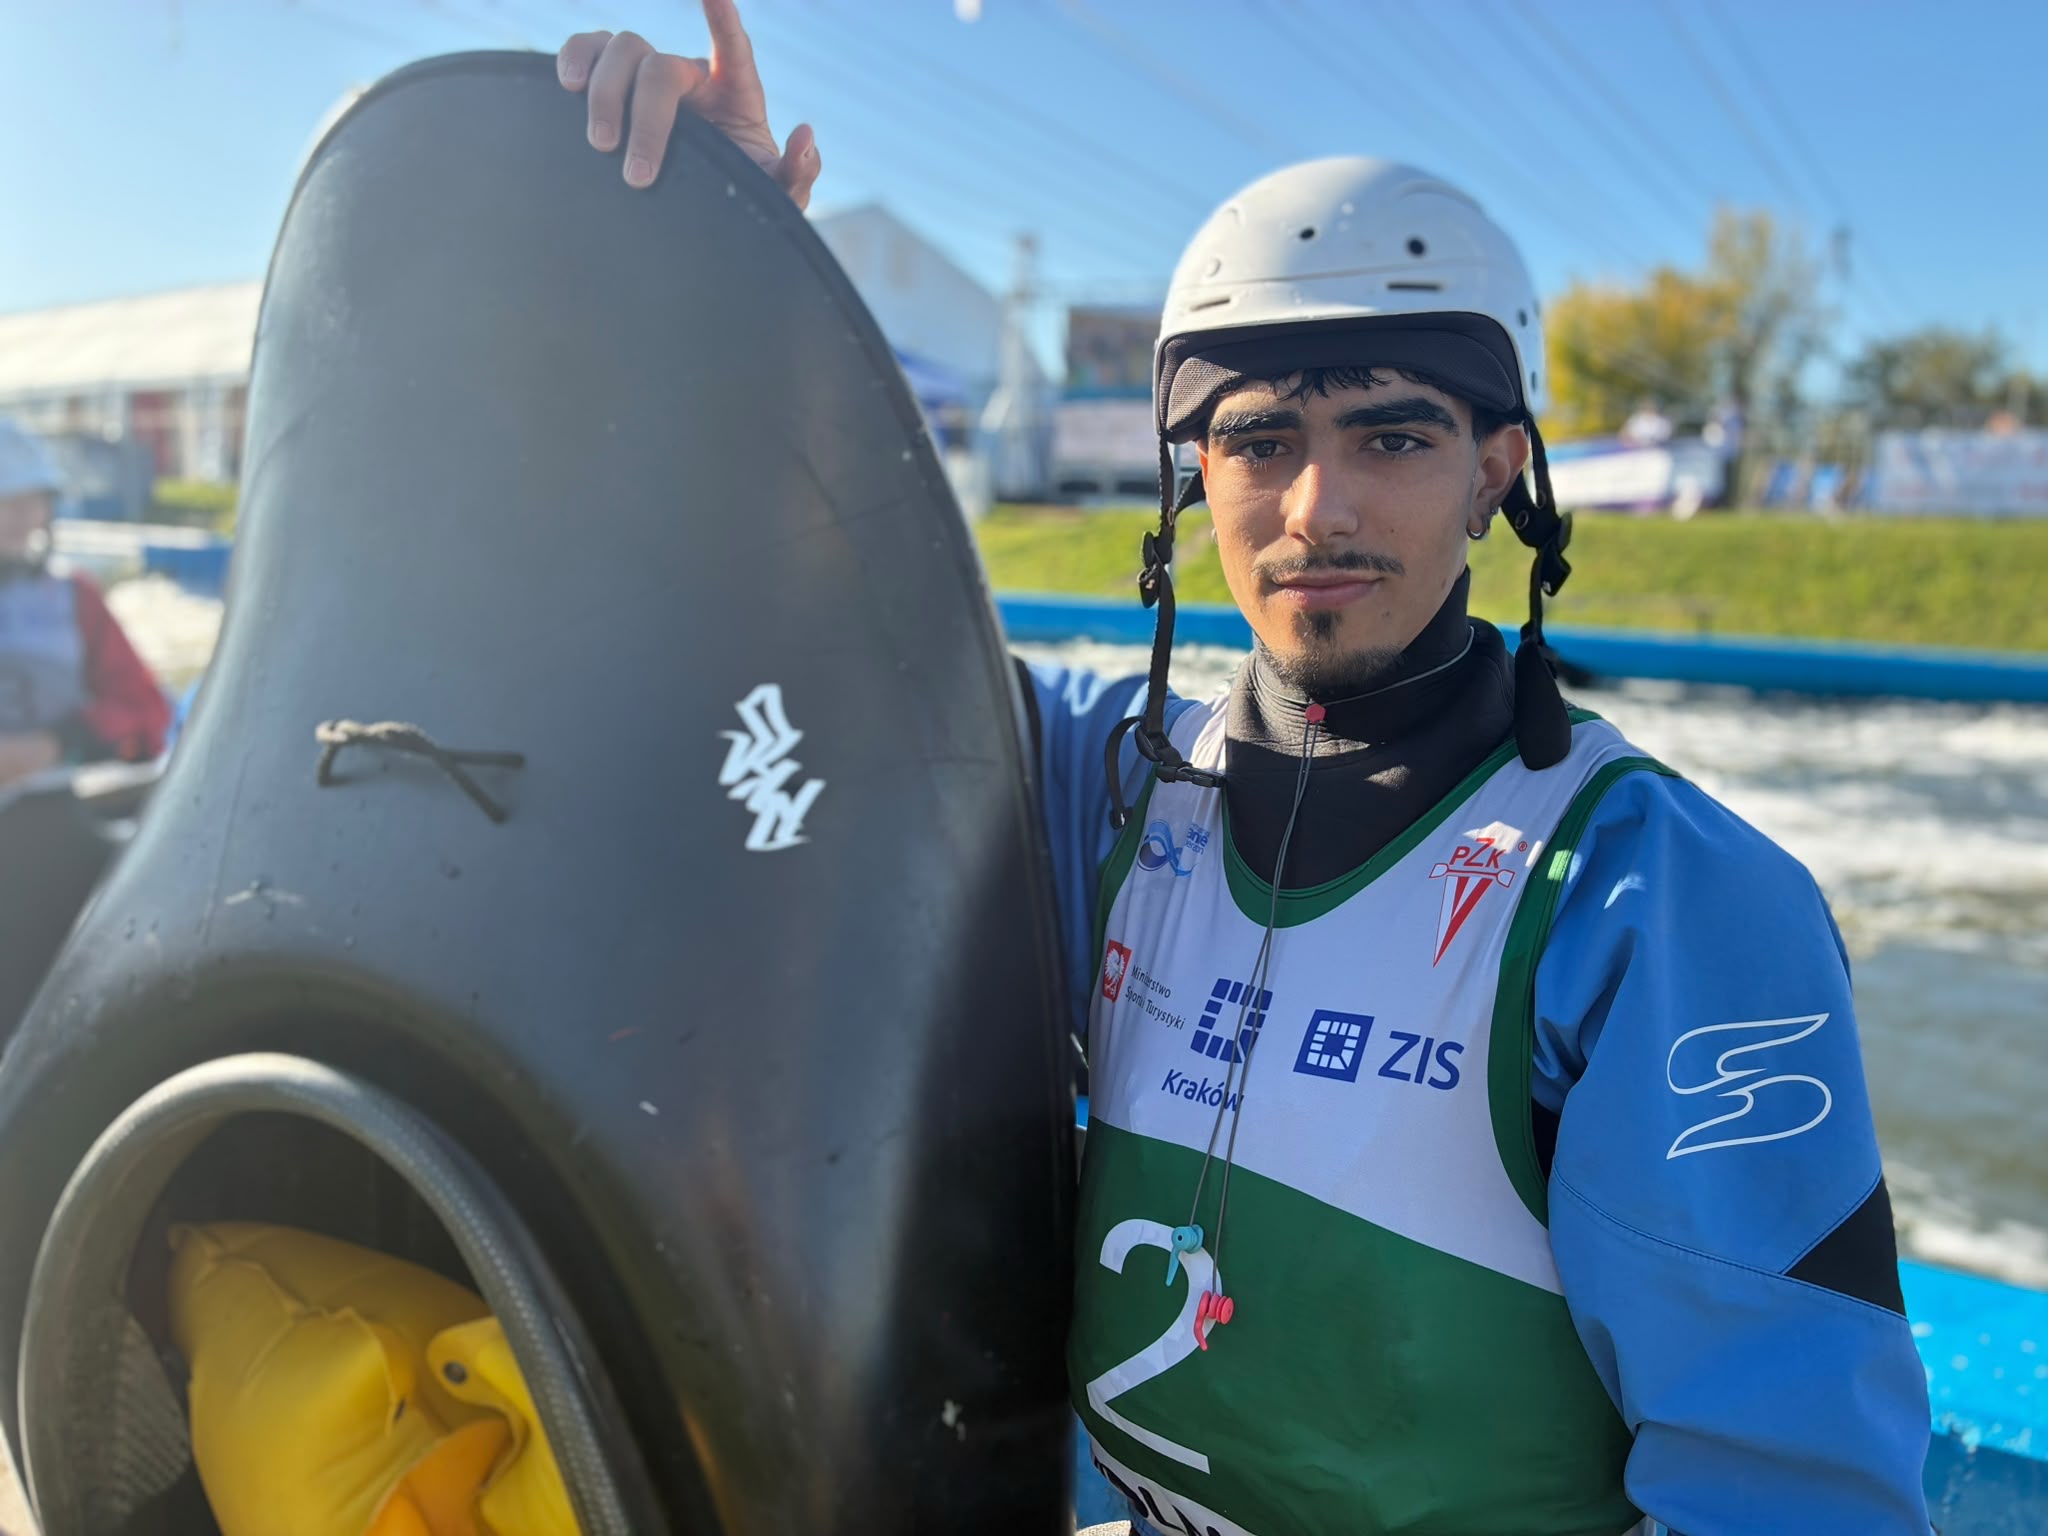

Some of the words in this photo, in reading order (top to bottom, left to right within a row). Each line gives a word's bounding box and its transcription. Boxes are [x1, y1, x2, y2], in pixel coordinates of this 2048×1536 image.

[1449, 837, 1507, 869] PZK
[1145, 999, 1187, 1031] Turystyki
[1377, 1030, 1465, 1091] ZIS
[1160, 1068, 1245, 1112] Kraków
[1086, 1218, 1223, 1475] 2
